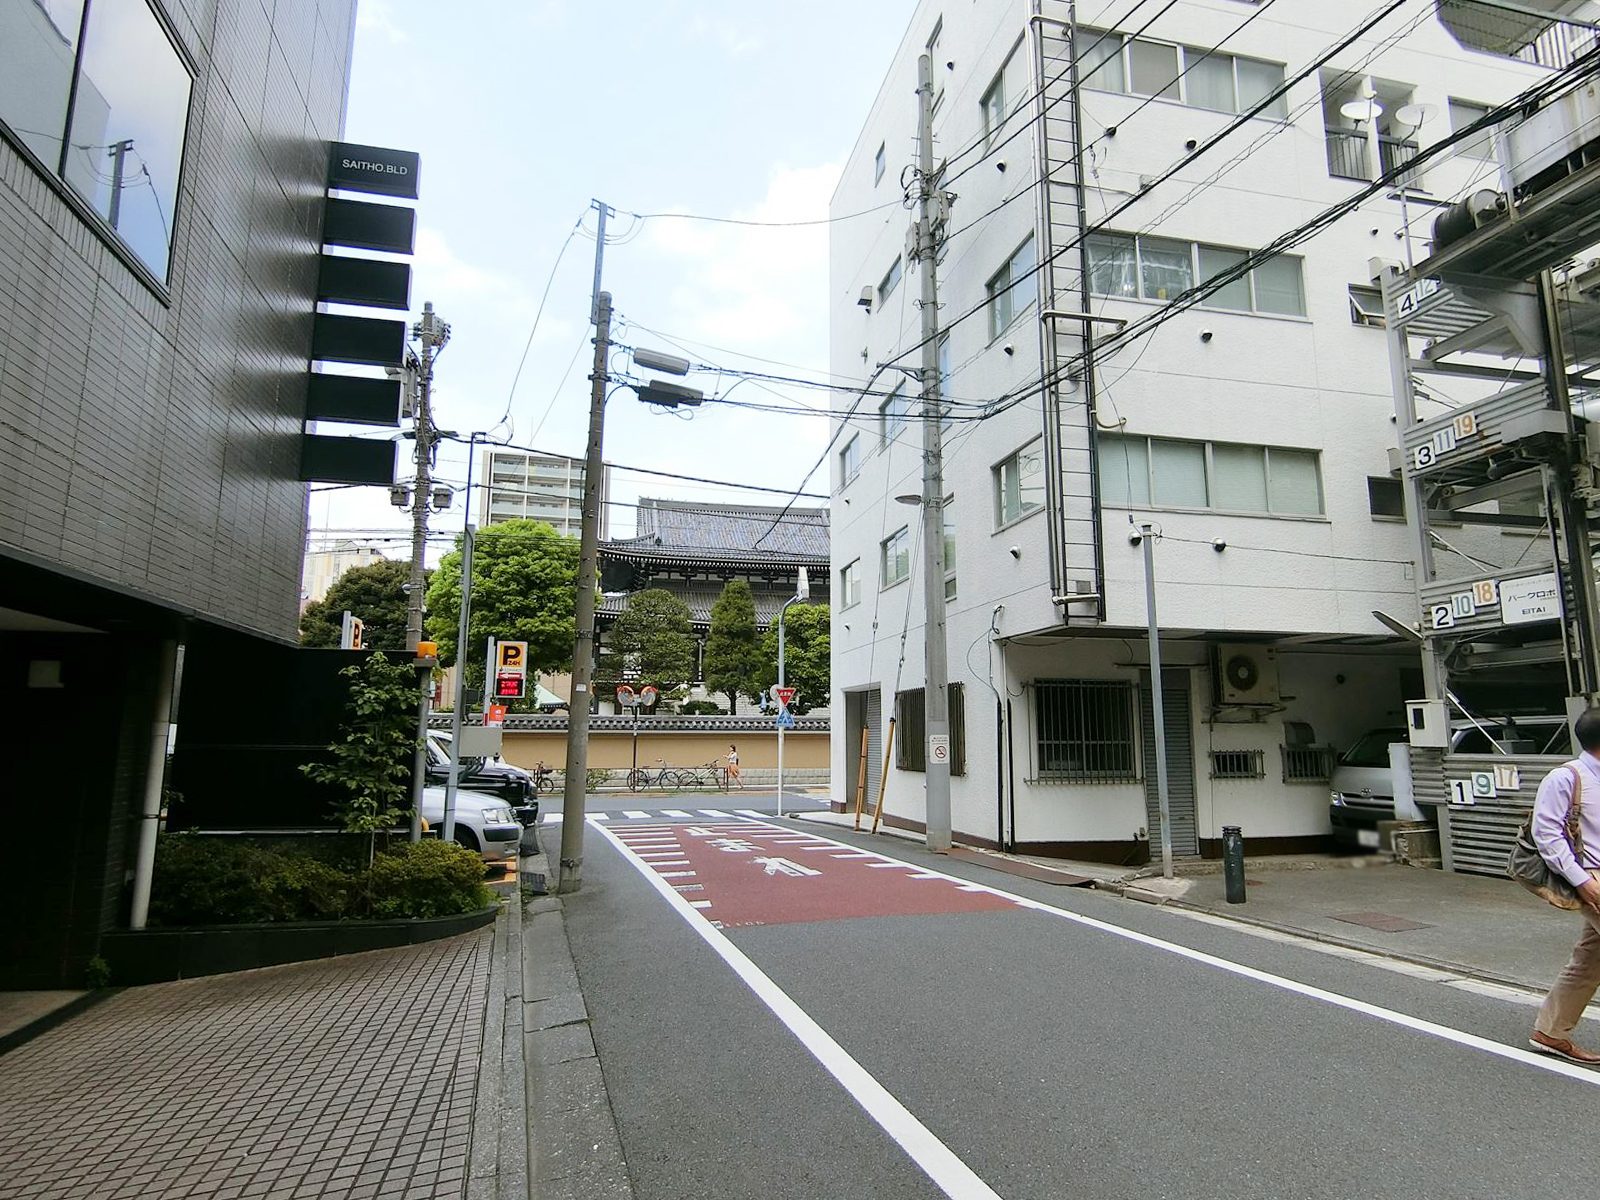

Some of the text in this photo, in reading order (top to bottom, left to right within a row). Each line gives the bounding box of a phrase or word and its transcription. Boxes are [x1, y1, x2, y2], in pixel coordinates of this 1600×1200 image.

[342, 159, 408, 175] SAITHO.BLD
[1401, 293, 1414, 312] 4
[1418, 415, 1473, 465] 3 11 19
[1435, 607, 1450, 626] 2
[1454, 597, 1471, 616] 10
[1474, 582, 1493, 603] 18
[1521, 606, 1546, 615] EITAI
[503, 646, 521, 666] P
[1455, 766, 1517, 802] 1 9 17
